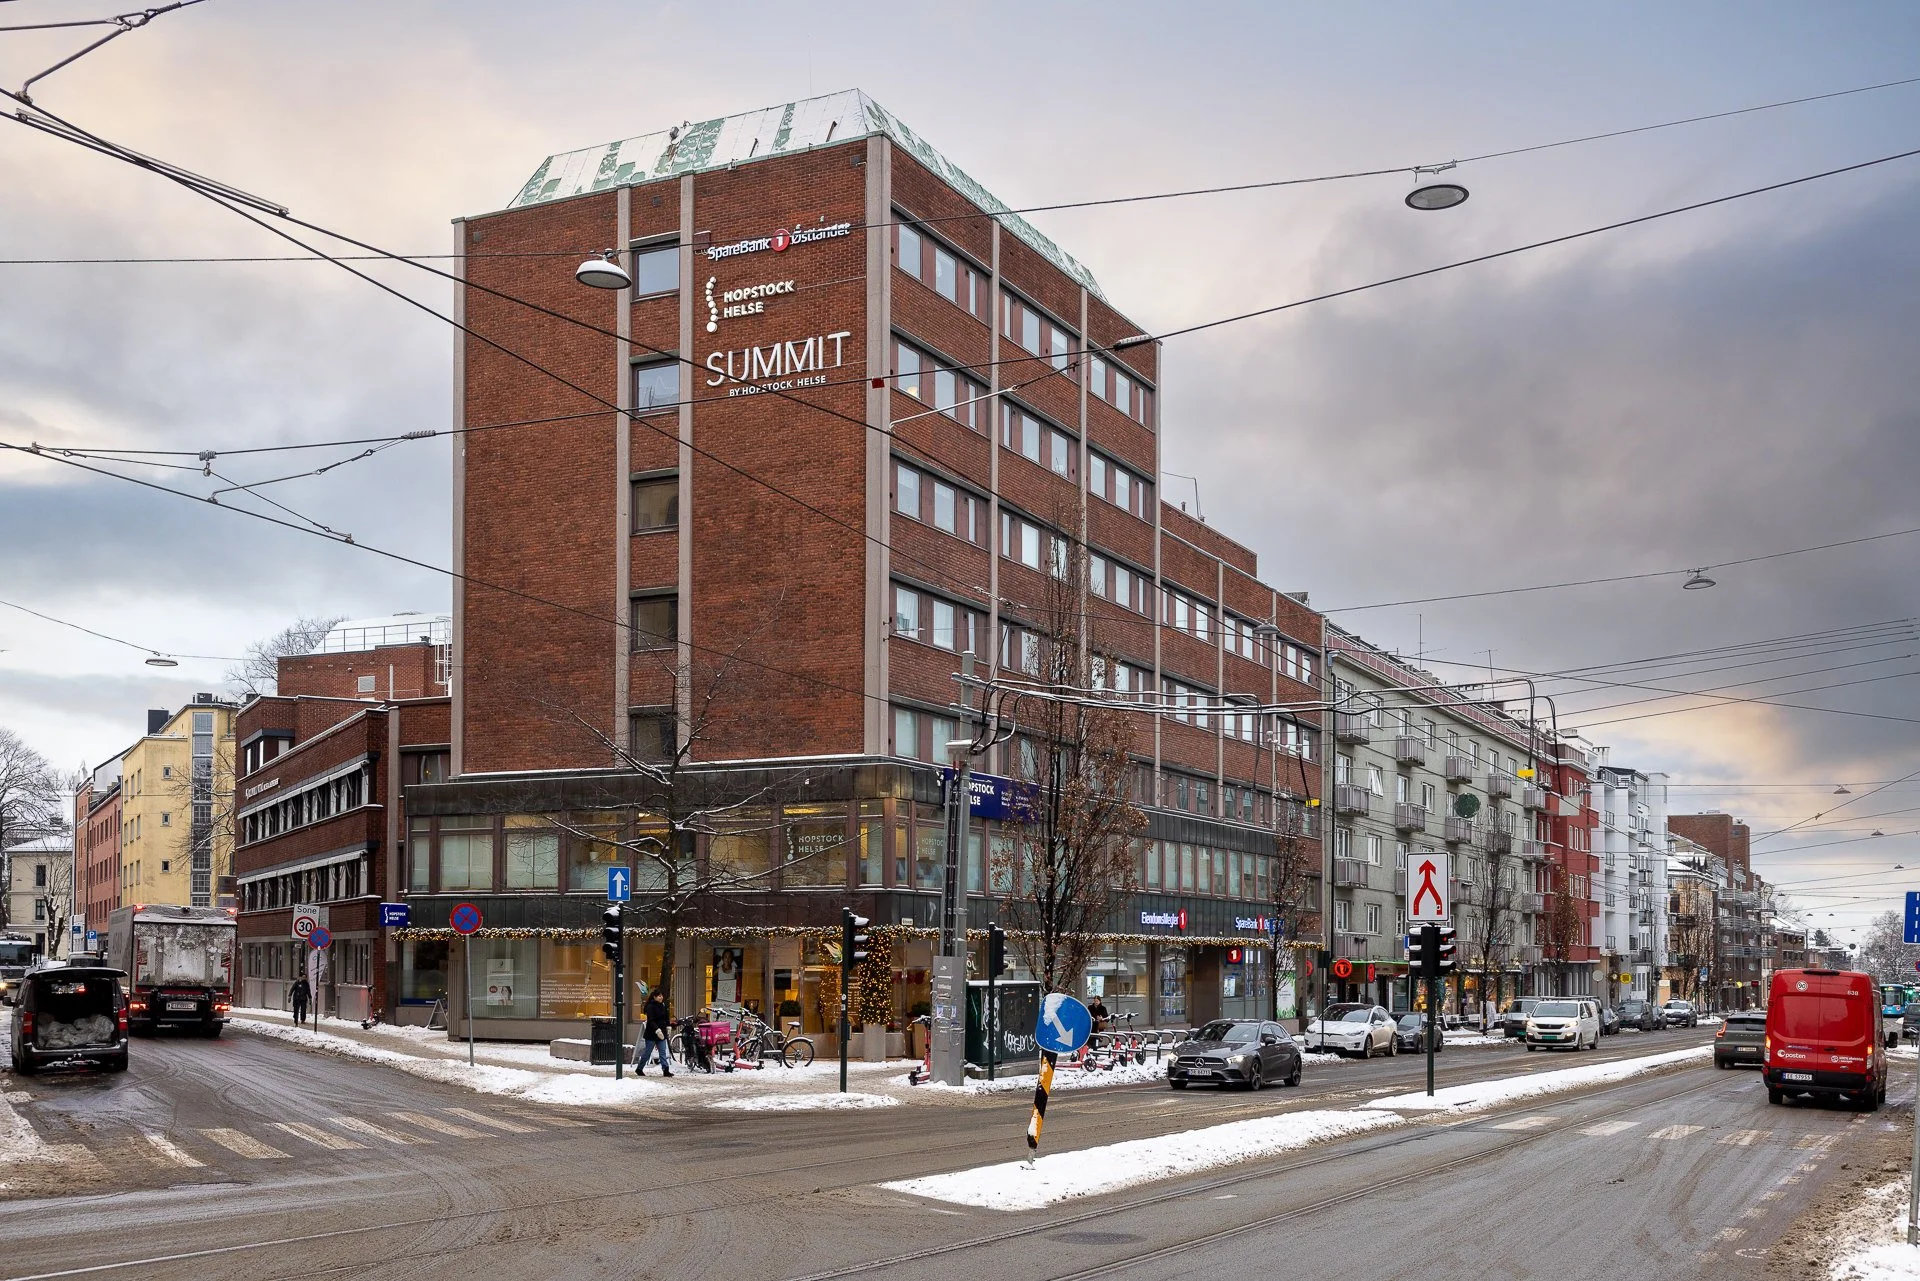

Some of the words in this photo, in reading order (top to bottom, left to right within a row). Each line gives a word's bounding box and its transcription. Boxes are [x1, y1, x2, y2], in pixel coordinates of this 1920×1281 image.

[708, 236, 772, 261] SpareBank
[723, 280, 795, 303] HOPSTOCK
[723, 301, 765, 318] HELSE
[706, 331, 851, 387] SUMMIT
[729, 388, 741, 397] BY
[742, 380, 793, 396] HOPSTOCK
[797, 375, 826, 387] HELSE
[798, 834, 844, 843] HOPSTOCK
[921, 837, 944, 847] HOPSTOC
[798, 845, 824, 853] HELSE
[297, 905, 317, 914] Sone
[298, 921, 313, 932] 30
[1235, 916, 1258, 930] SpareBank
[1230, 949, 1237, 960] 1
[1797, 981, 1806, 989] 90
